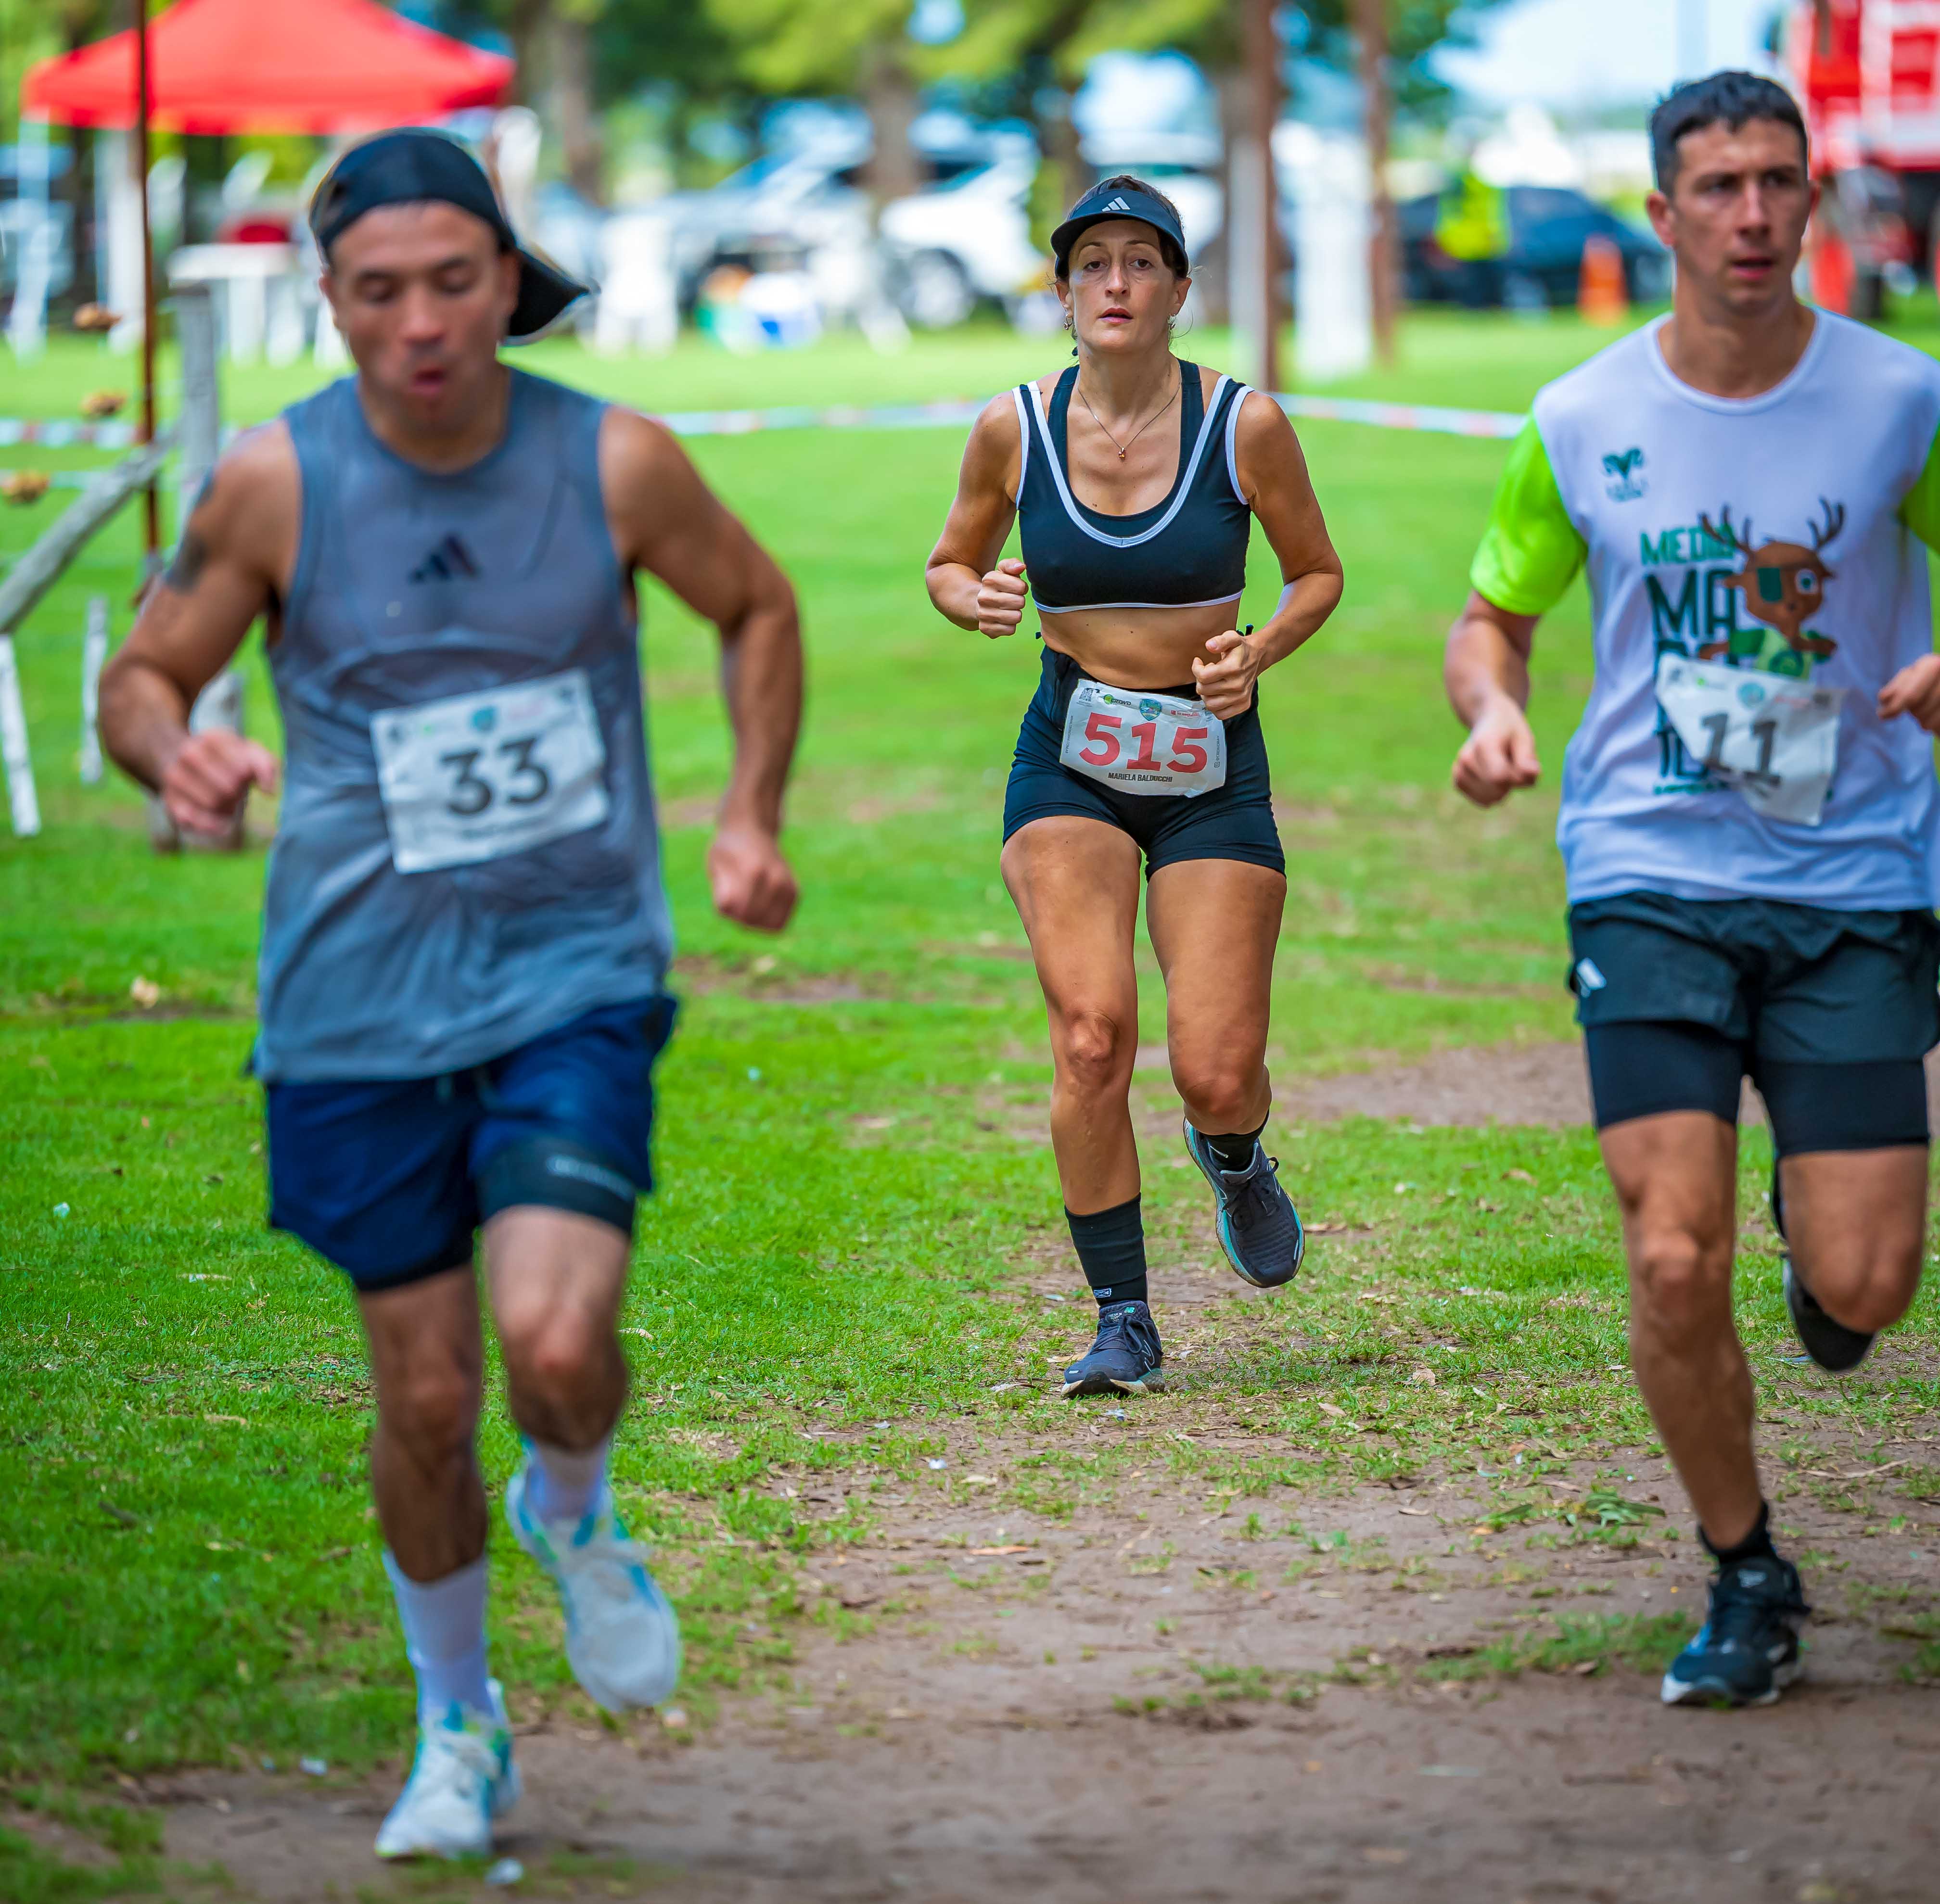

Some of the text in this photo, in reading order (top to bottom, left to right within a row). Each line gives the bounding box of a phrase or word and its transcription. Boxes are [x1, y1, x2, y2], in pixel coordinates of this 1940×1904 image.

[439, 736, 549, 816] 33
[1079, 712, 1208, 774] 515
[1108, 772, 1173, 782] MARIELA BALDUCCHI
[1701, 712, 1781, 787] 11
